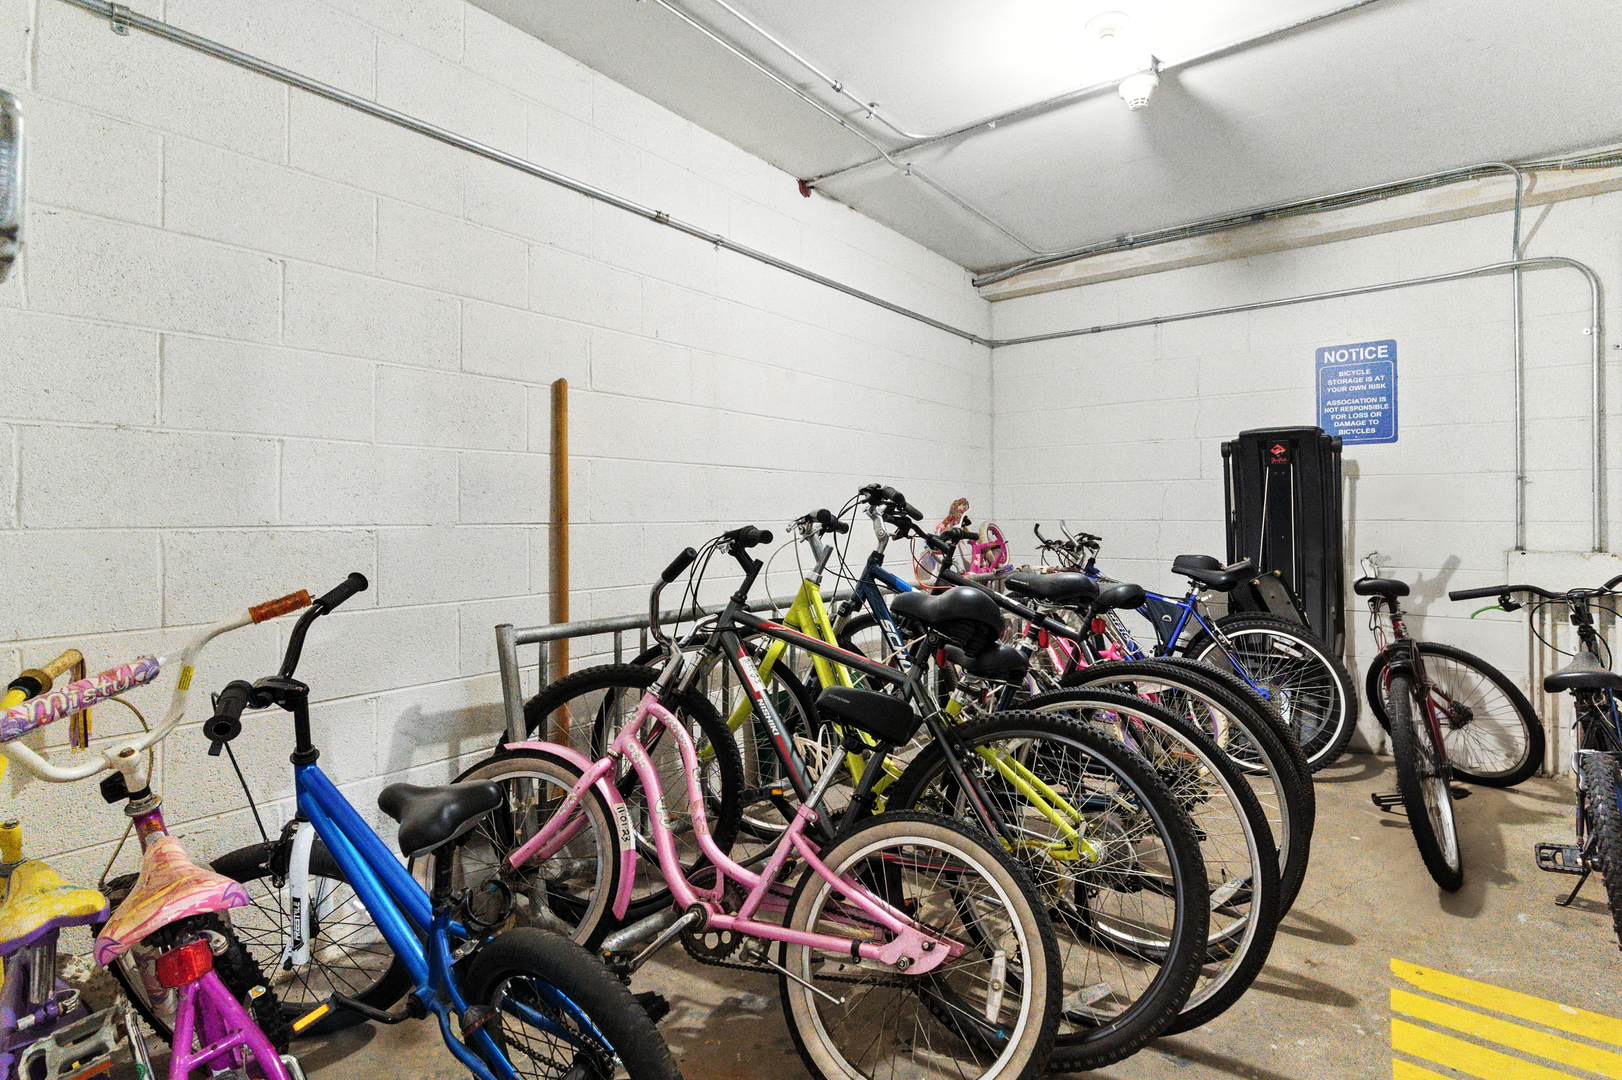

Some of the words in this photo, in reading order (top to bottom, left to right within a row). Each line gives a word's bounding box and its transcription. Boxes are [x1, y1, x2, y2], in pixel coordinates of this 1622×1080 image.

[1324, 345, 1388, 364] NOTICE
[1338, 368, 1371, 376] BICYCLE
[1327, 376, 1364, 386] STORAGE
[1326, 397, 1377, 406] ASSOCIATION
[1340, 404, 1389, 412] RESPONSIBLE
[758, 698, 780, 736] NISHIKI
